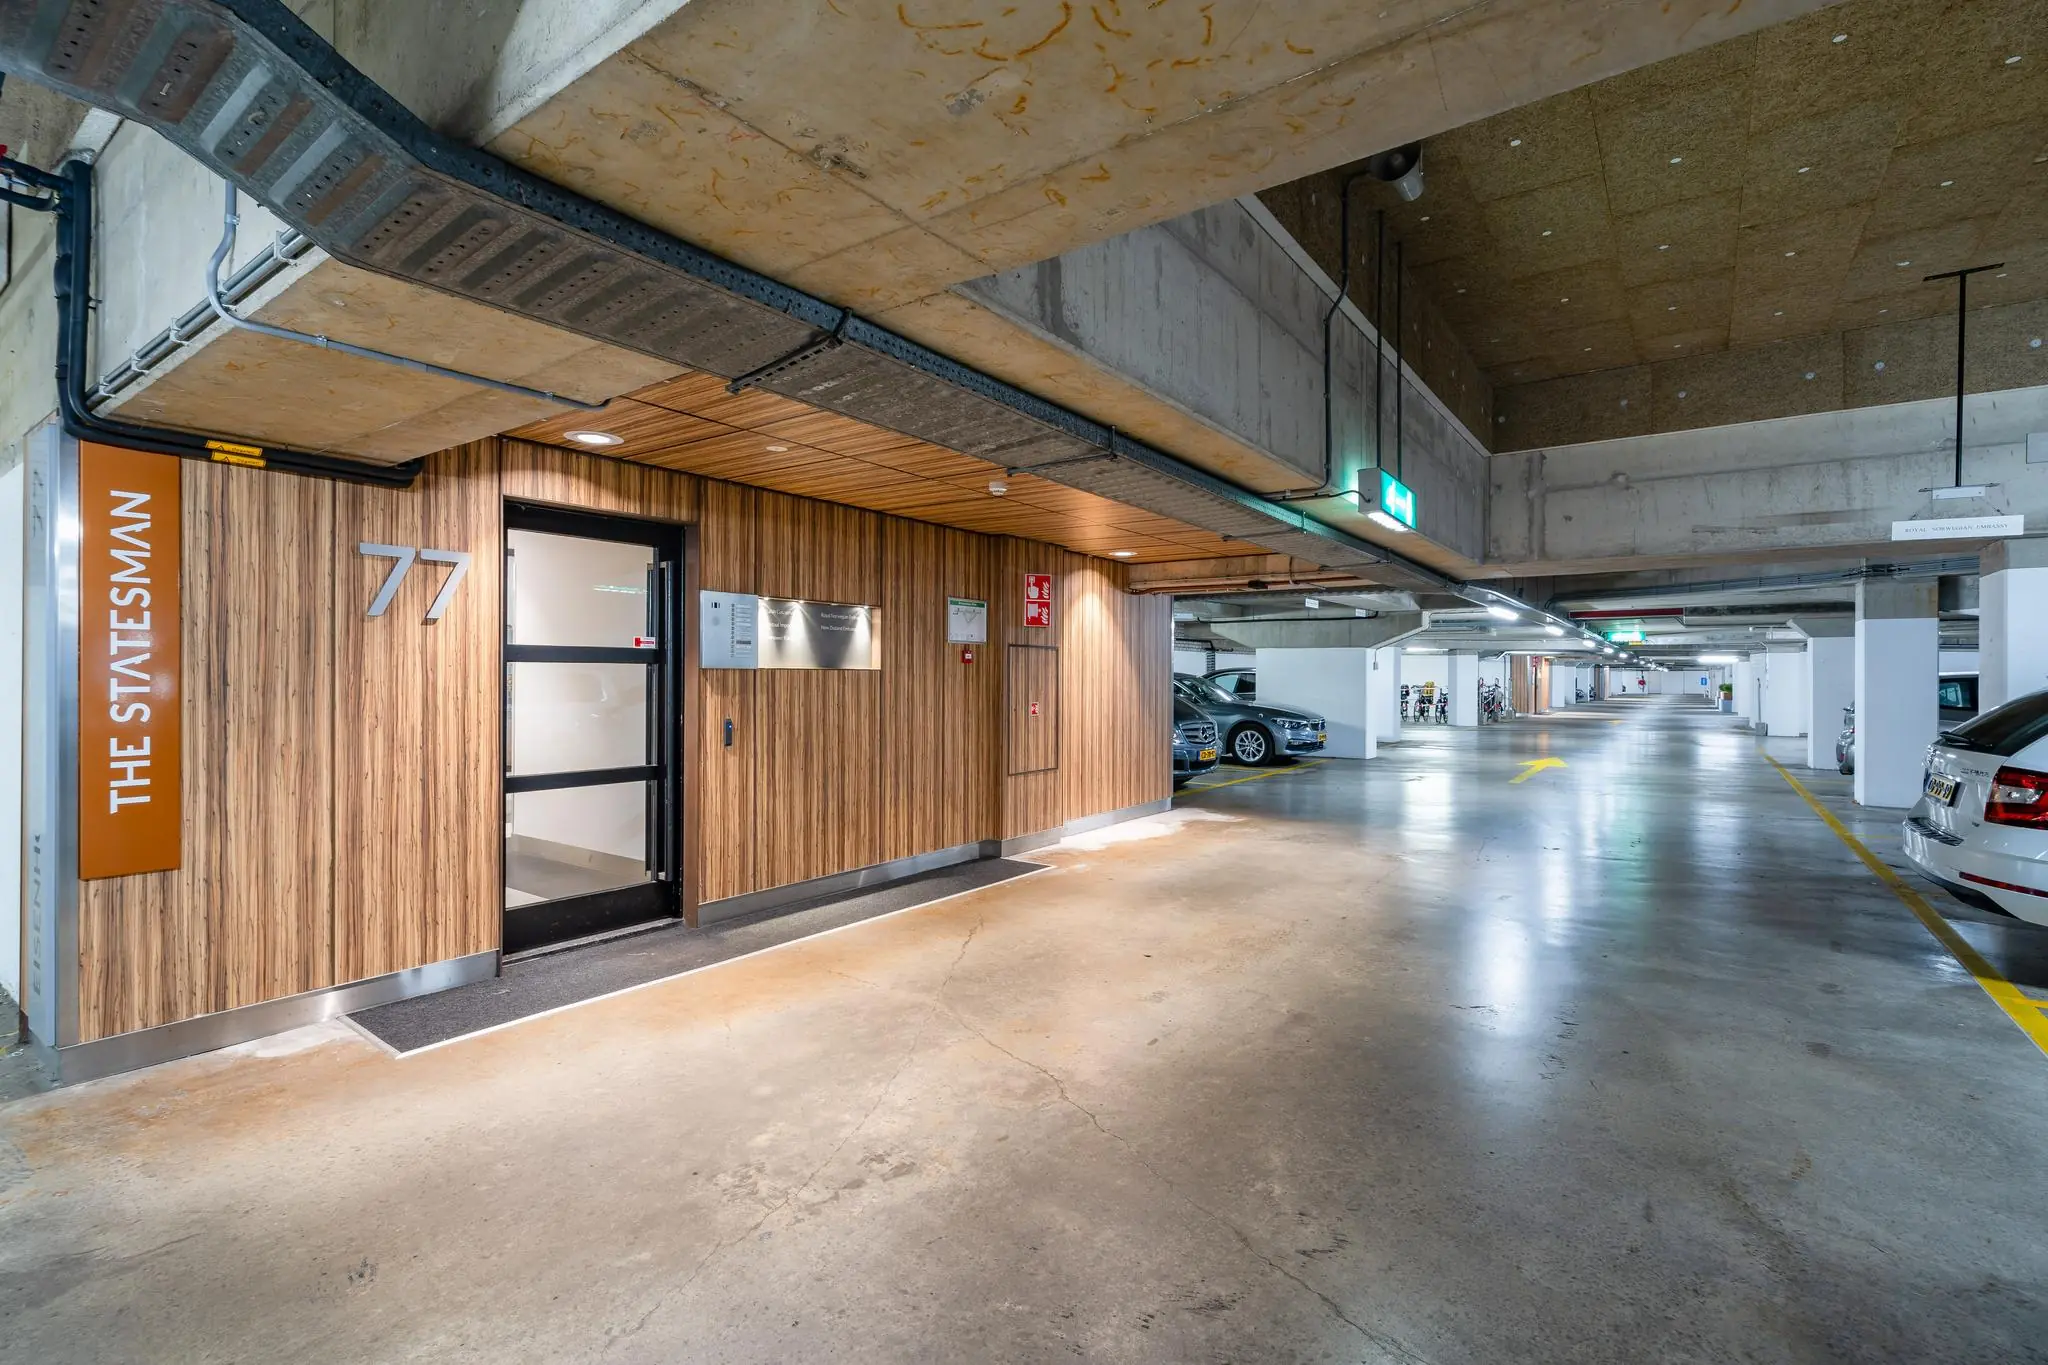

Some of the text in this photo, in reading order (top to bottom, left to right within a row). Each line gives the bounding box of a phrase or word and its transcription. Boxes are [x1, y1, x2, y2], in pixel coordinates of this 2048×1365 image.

[110, 489, 151, 815] THE STATESMAN
[359, 542, 472, 619] 77
